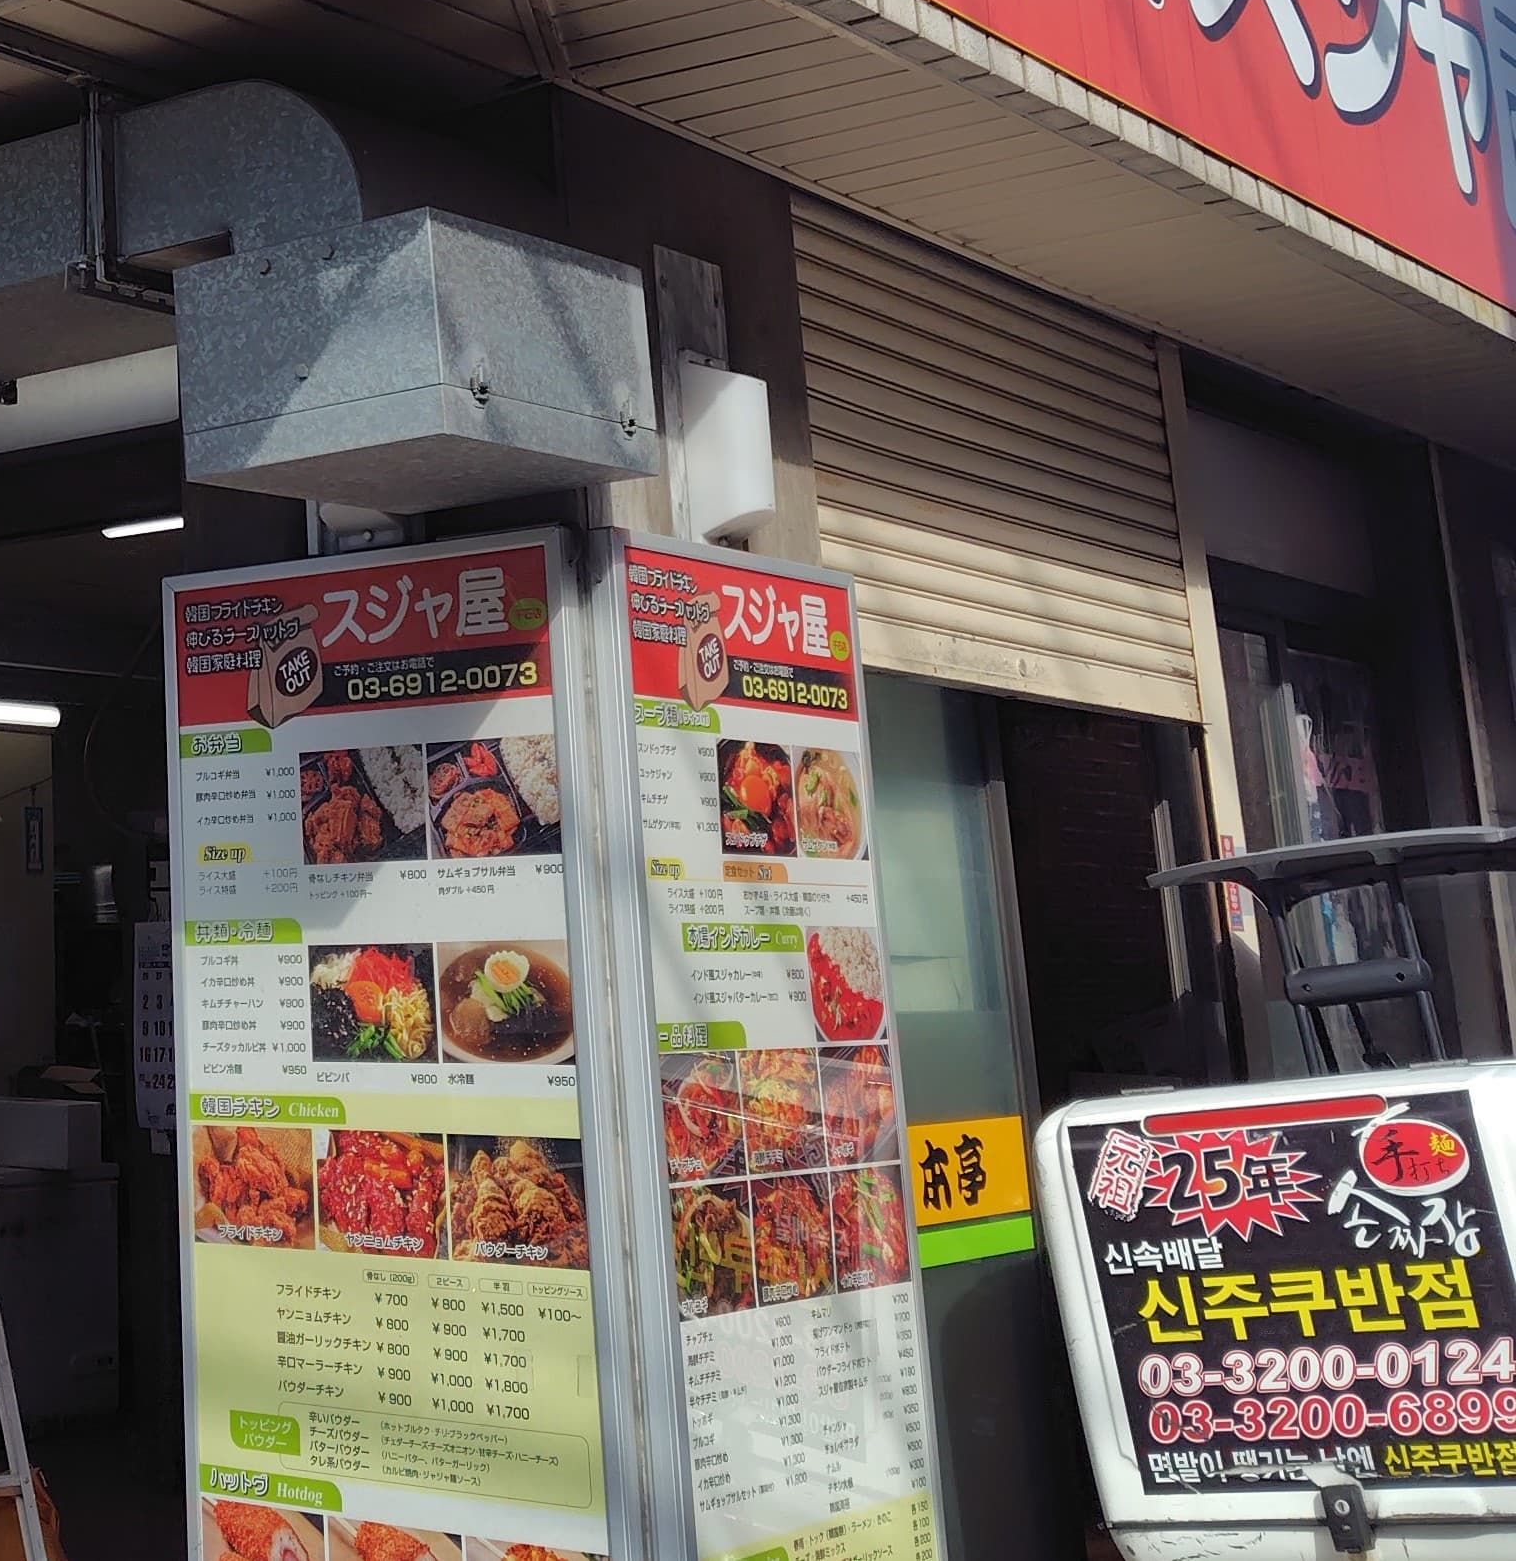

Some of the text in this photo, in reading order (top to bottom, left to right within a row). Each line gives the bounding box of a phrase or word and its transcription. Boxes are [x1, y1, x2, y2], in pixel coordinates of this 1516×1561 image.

[185, 596, 283, 623] 韓国フライドチキン
[322, 567, 509, 648] スジャ屋
[722, 585, 831, 658] スジャ屋
[698, 637, 719, 661] TAKE
[186, 649, 262, 674] 韓国家庭料理
[279, 649, 311, 677] TAKE
[703, 657, 721, 679] OUT
[285, 665, 312, 693] OUT
[347, 661, 538, 701] 03-6912-0073
[742, 676, 848, 709] 03-6912-0073
[191, 732, 242, 756] お弁当
[265, 767, 295, 778] ¥1,000
[266, 789, 296, 800] ¥1,000
[267, 812, 297, 822] ¥1,000
[204, 846, 246, 863] Size up
[278, 954, 302, 964] ¥900
[279, 976, 303, 986] ¥900
[201, 998, 304, 1009] キムチチャーハン ¥900
[281, 1020, 305, 1031] ¥900
[658, 1023, 708, 1048] 一品料理
[283, 1065, 307, 1075] ¥950
[411, 1073, 437, 1085] ¥800
[548, 1075, 575, 1087] ¥950
[201, 1095, 339, 1119] 韓国チキン Chicken
[1157, 1144, 1298, 1215] 25年
[218, 1224, 283, 1241] フライドチキン
[1103, 1236, 1226, 1276] 신속배달
[276, 1284, 524, 1317] フライドチキン ¥1,500
[1137, 1257, 1482, 1345] 신주쿠반점
[277, 1308, 525, 1343] ヤンニョムチキン ¥1,700
[484, 1353, 527, 1368] ¥1,700
[1138, 1337, 1516, 1398] 03-3200-0124
[431, 1373, 473, 1388] ¥1,000
[485, 1379, 528, 1394] ¥1,800
[432, 1398, 474, 1414] ¥1,000
[487, 1404, 530, 1420] ¥1,700
[1148, 1388, 1516, 1444] 03-3200-6899
[1147, 1450, 1228, 1484] 면발이
[209, 1467, 323, 1506] ハットグ Hotdog
